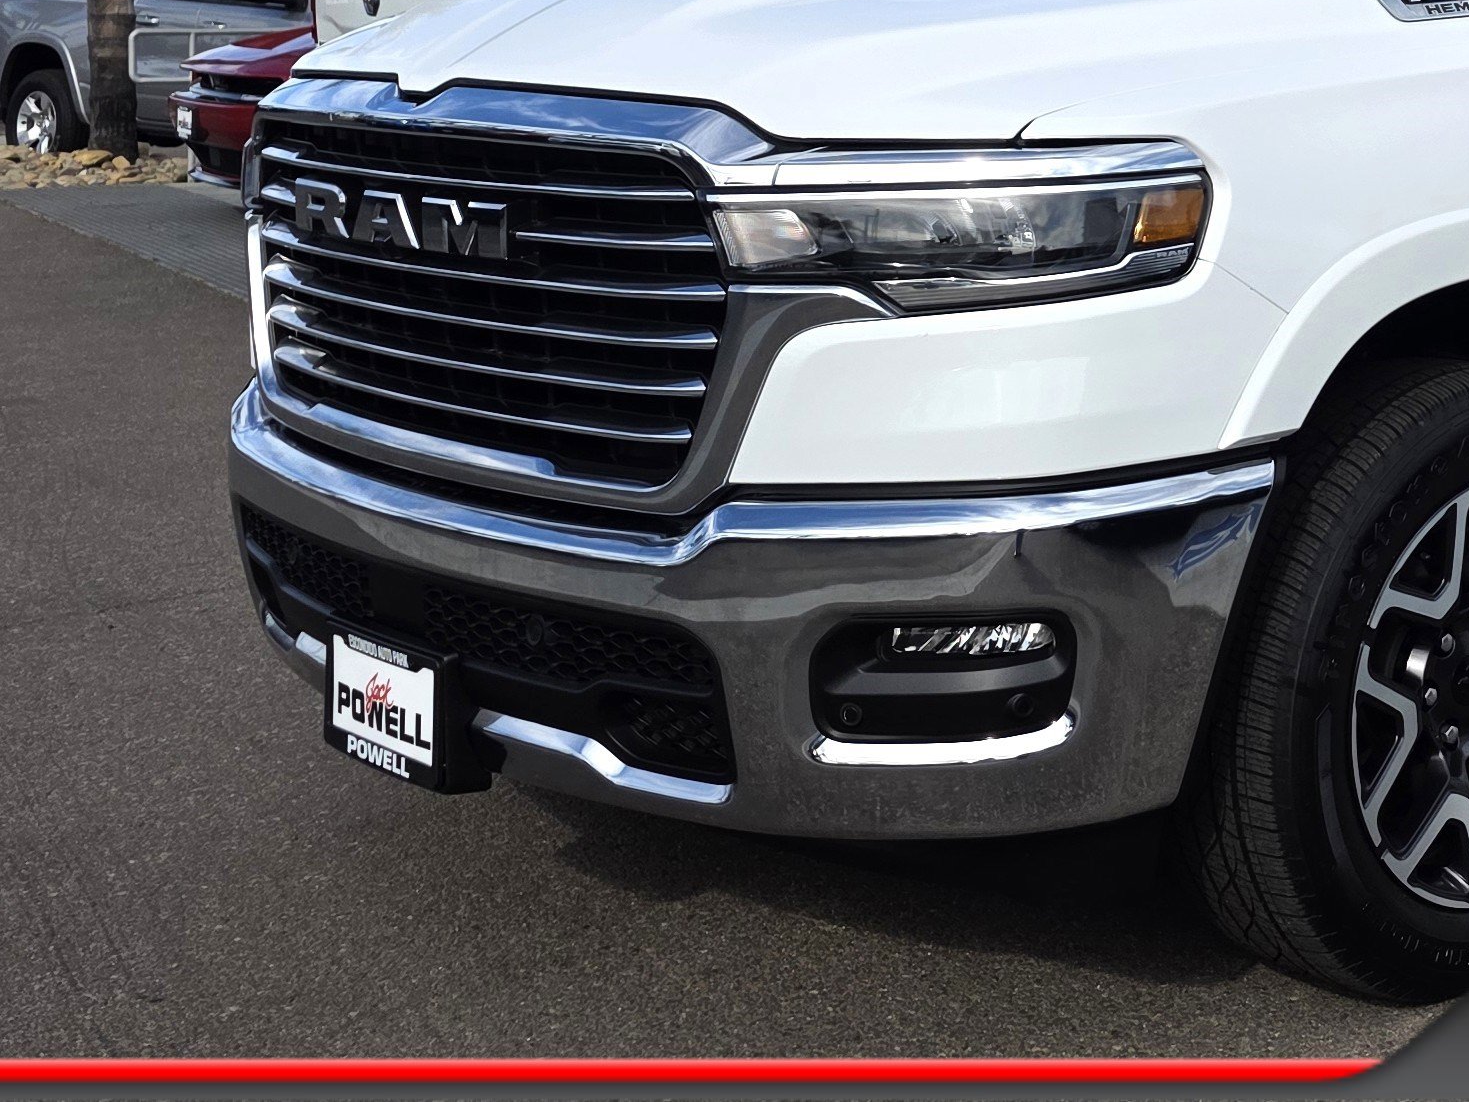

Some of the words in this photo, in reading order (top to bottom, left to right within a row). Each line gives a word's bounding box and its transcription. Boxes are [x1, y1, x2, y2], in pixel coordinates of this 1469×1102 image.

[295, 177, 508, 260] RAM
[337, 681, 432, 751] POWELL
[366, 672, 394, 715] Jack
[347, 734, 410, 779] POWELL
